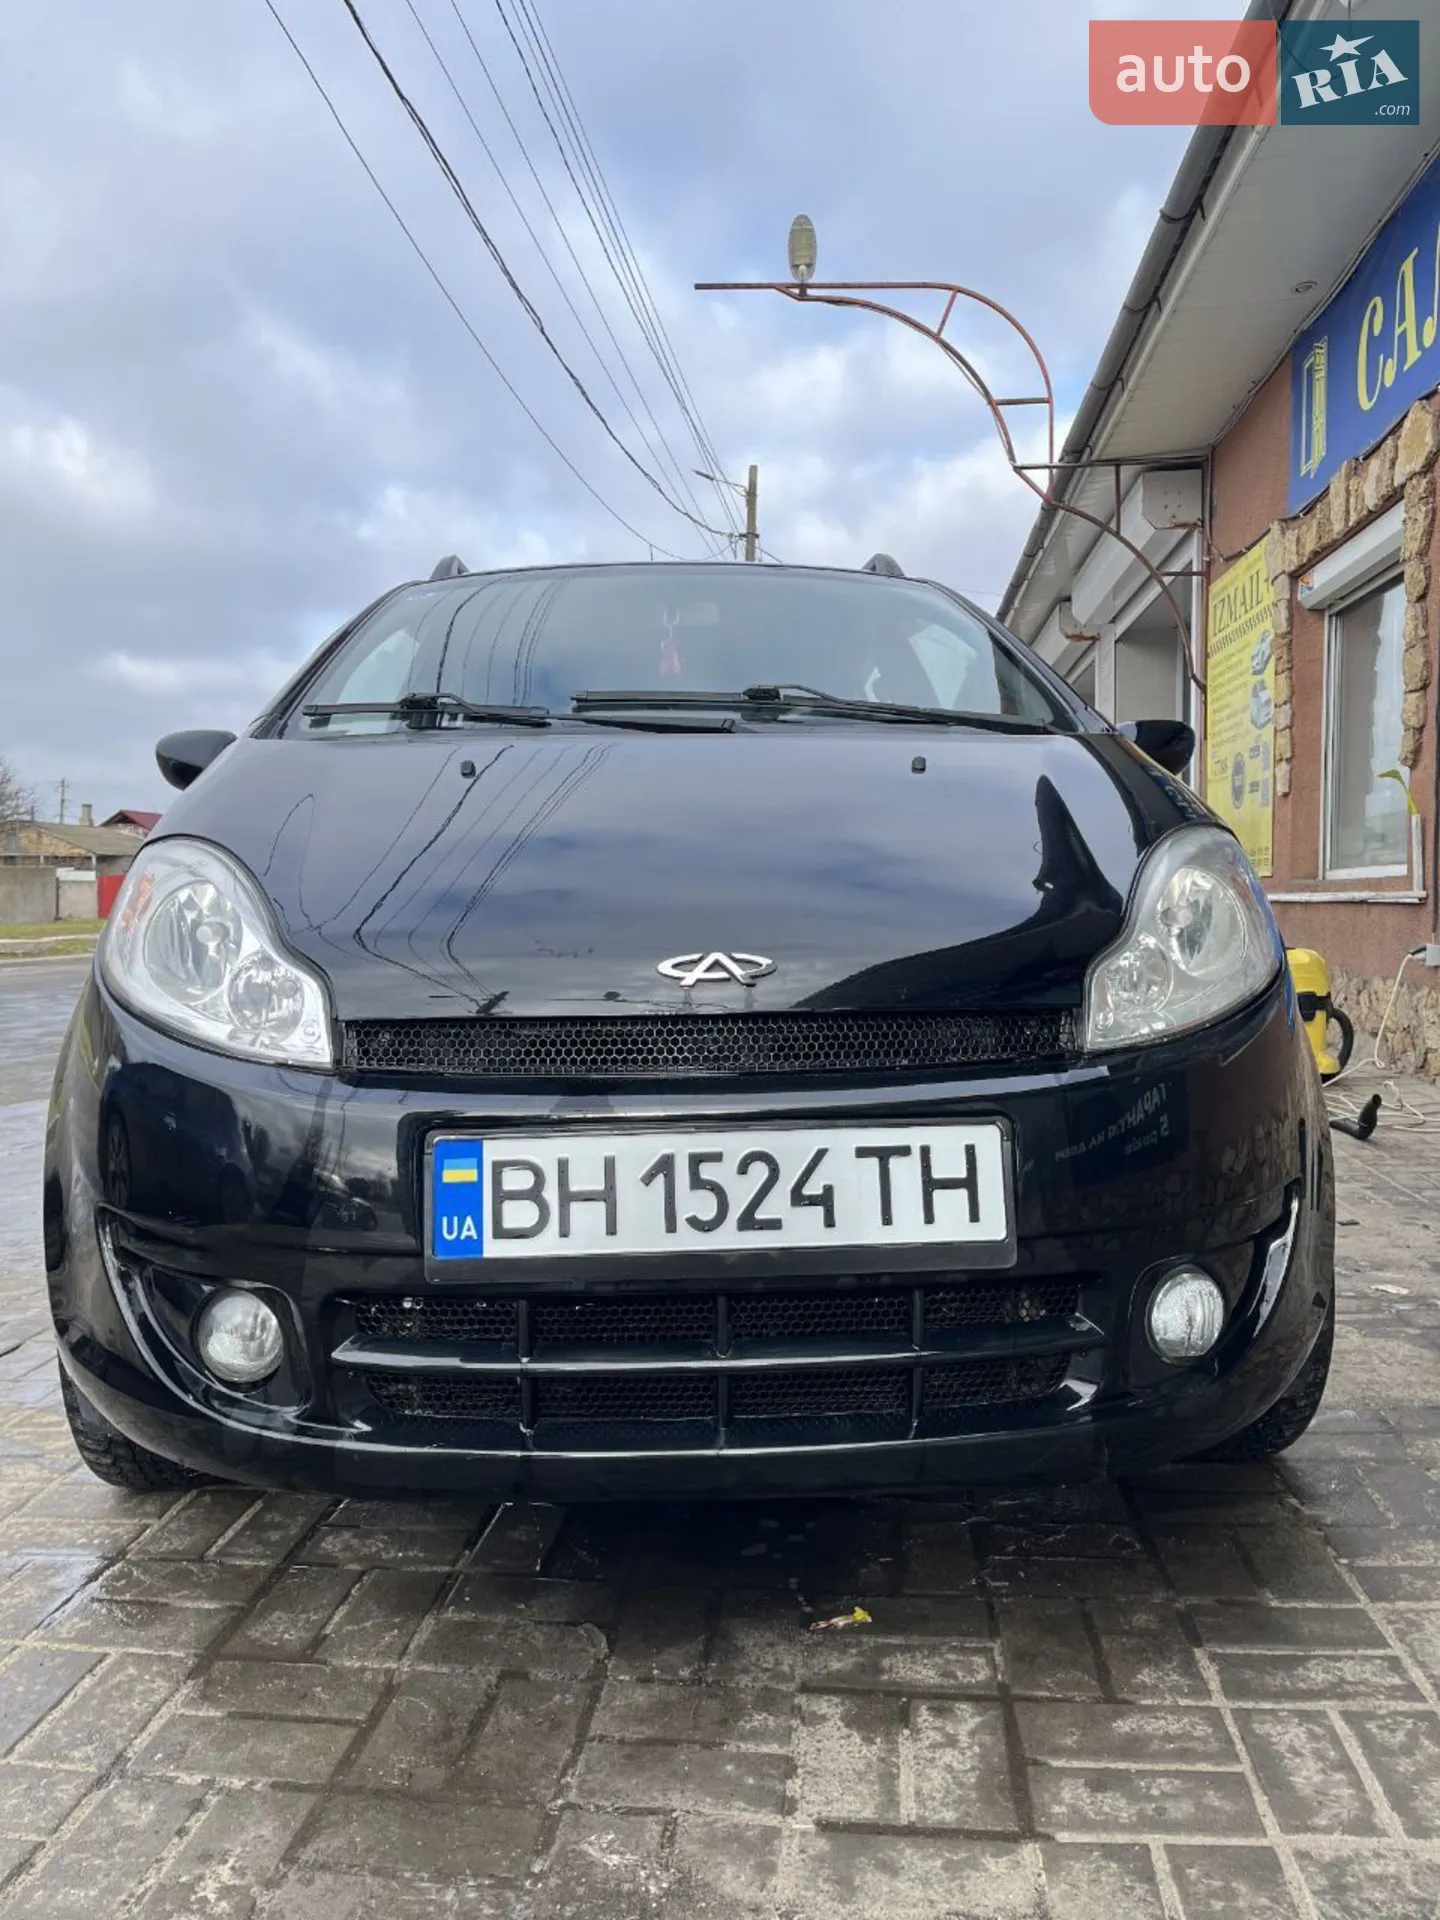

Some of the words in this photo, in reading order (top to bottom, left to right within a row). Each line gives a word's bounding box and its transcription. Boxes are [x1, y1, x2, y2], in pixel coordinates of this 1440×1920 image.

[491, 1154, 617, 1239] BH
[640, 1147, 835, 1234] 1524
[855, 1143, 981, 1227] TH
[441, 1215, 478, 1241] UA
